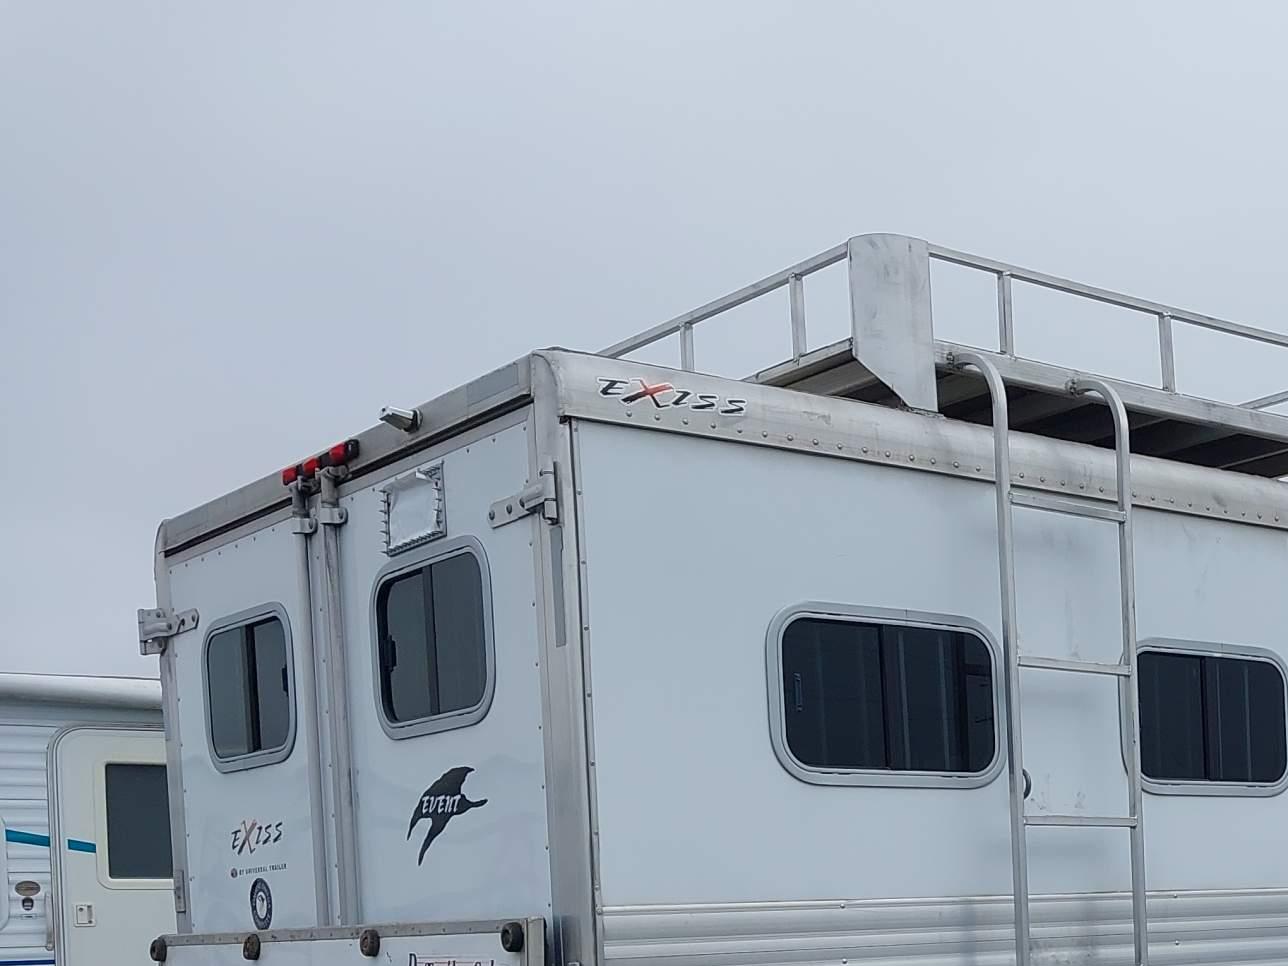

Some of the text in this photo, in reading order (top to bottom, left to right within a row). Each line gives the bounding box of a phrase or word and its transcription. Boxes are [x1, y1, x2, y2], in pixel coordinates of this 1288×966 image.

[598, 378, 746, 414] EXISS
[421, 794, 462, 814] EVENT
[231, 819, 283, 855] EXISS
